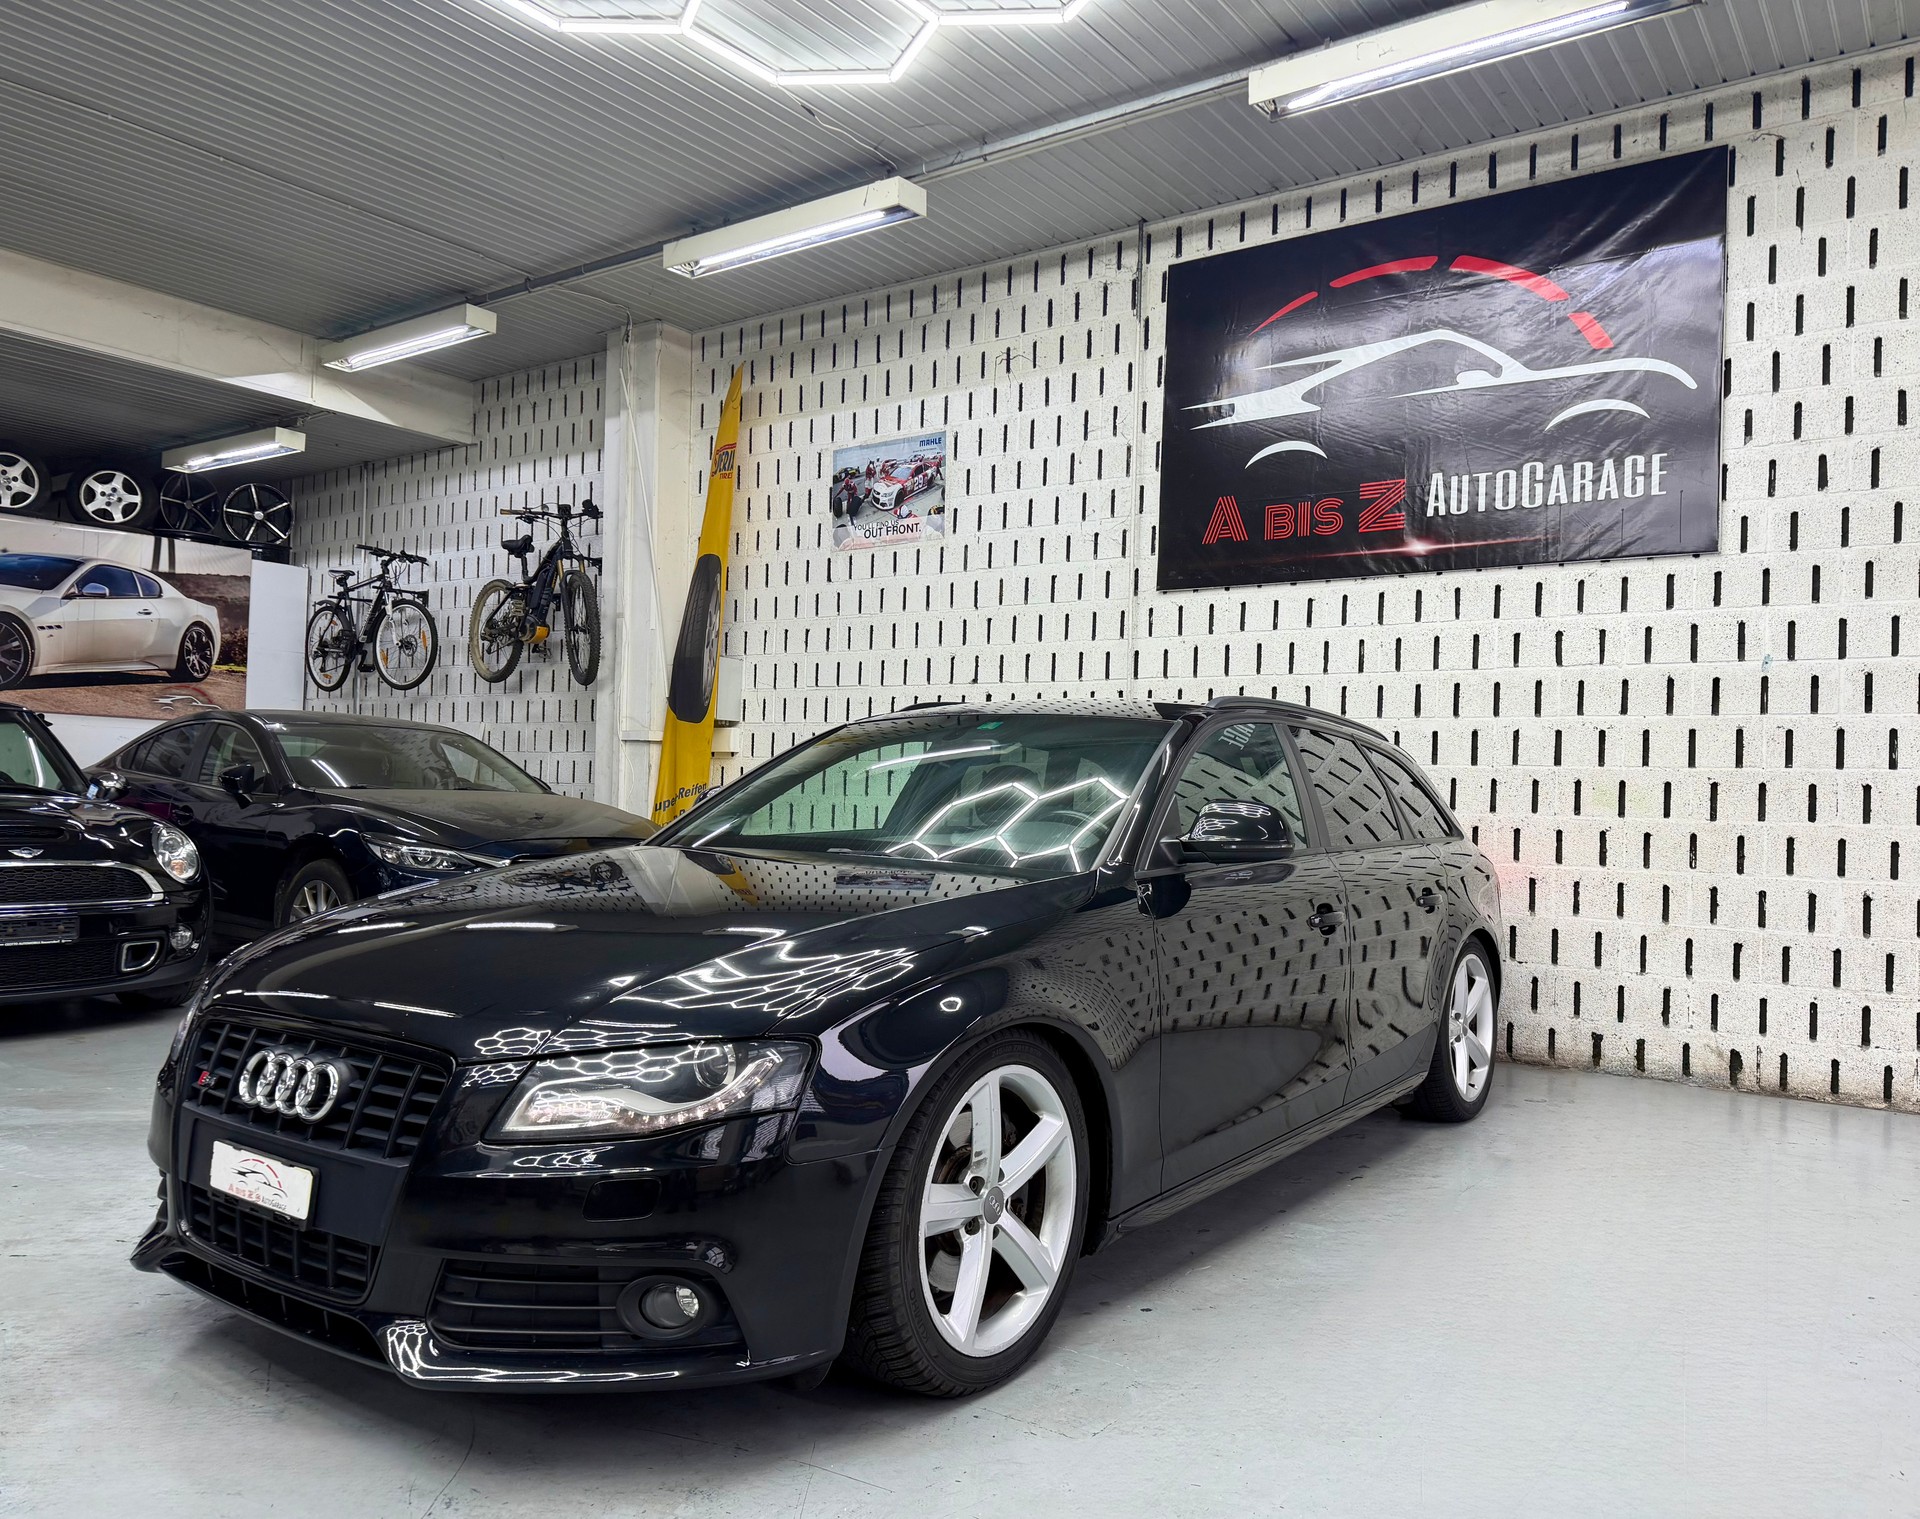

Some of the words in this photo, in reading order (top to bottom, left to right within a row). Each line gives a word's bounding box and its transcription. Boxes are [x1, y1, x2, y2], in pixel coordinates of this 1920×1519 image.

[919, 437, 942, 447] MAHLE
[914, 474, 923, 491] 29
[1201, 495, 1249, 545] A
[1264, 497, 1344, 541] BIS
[1358, 479, 1406, 532] Z
[864, 527, 883, 539] OUT
[886, 522, 922, 536] FRONT.
